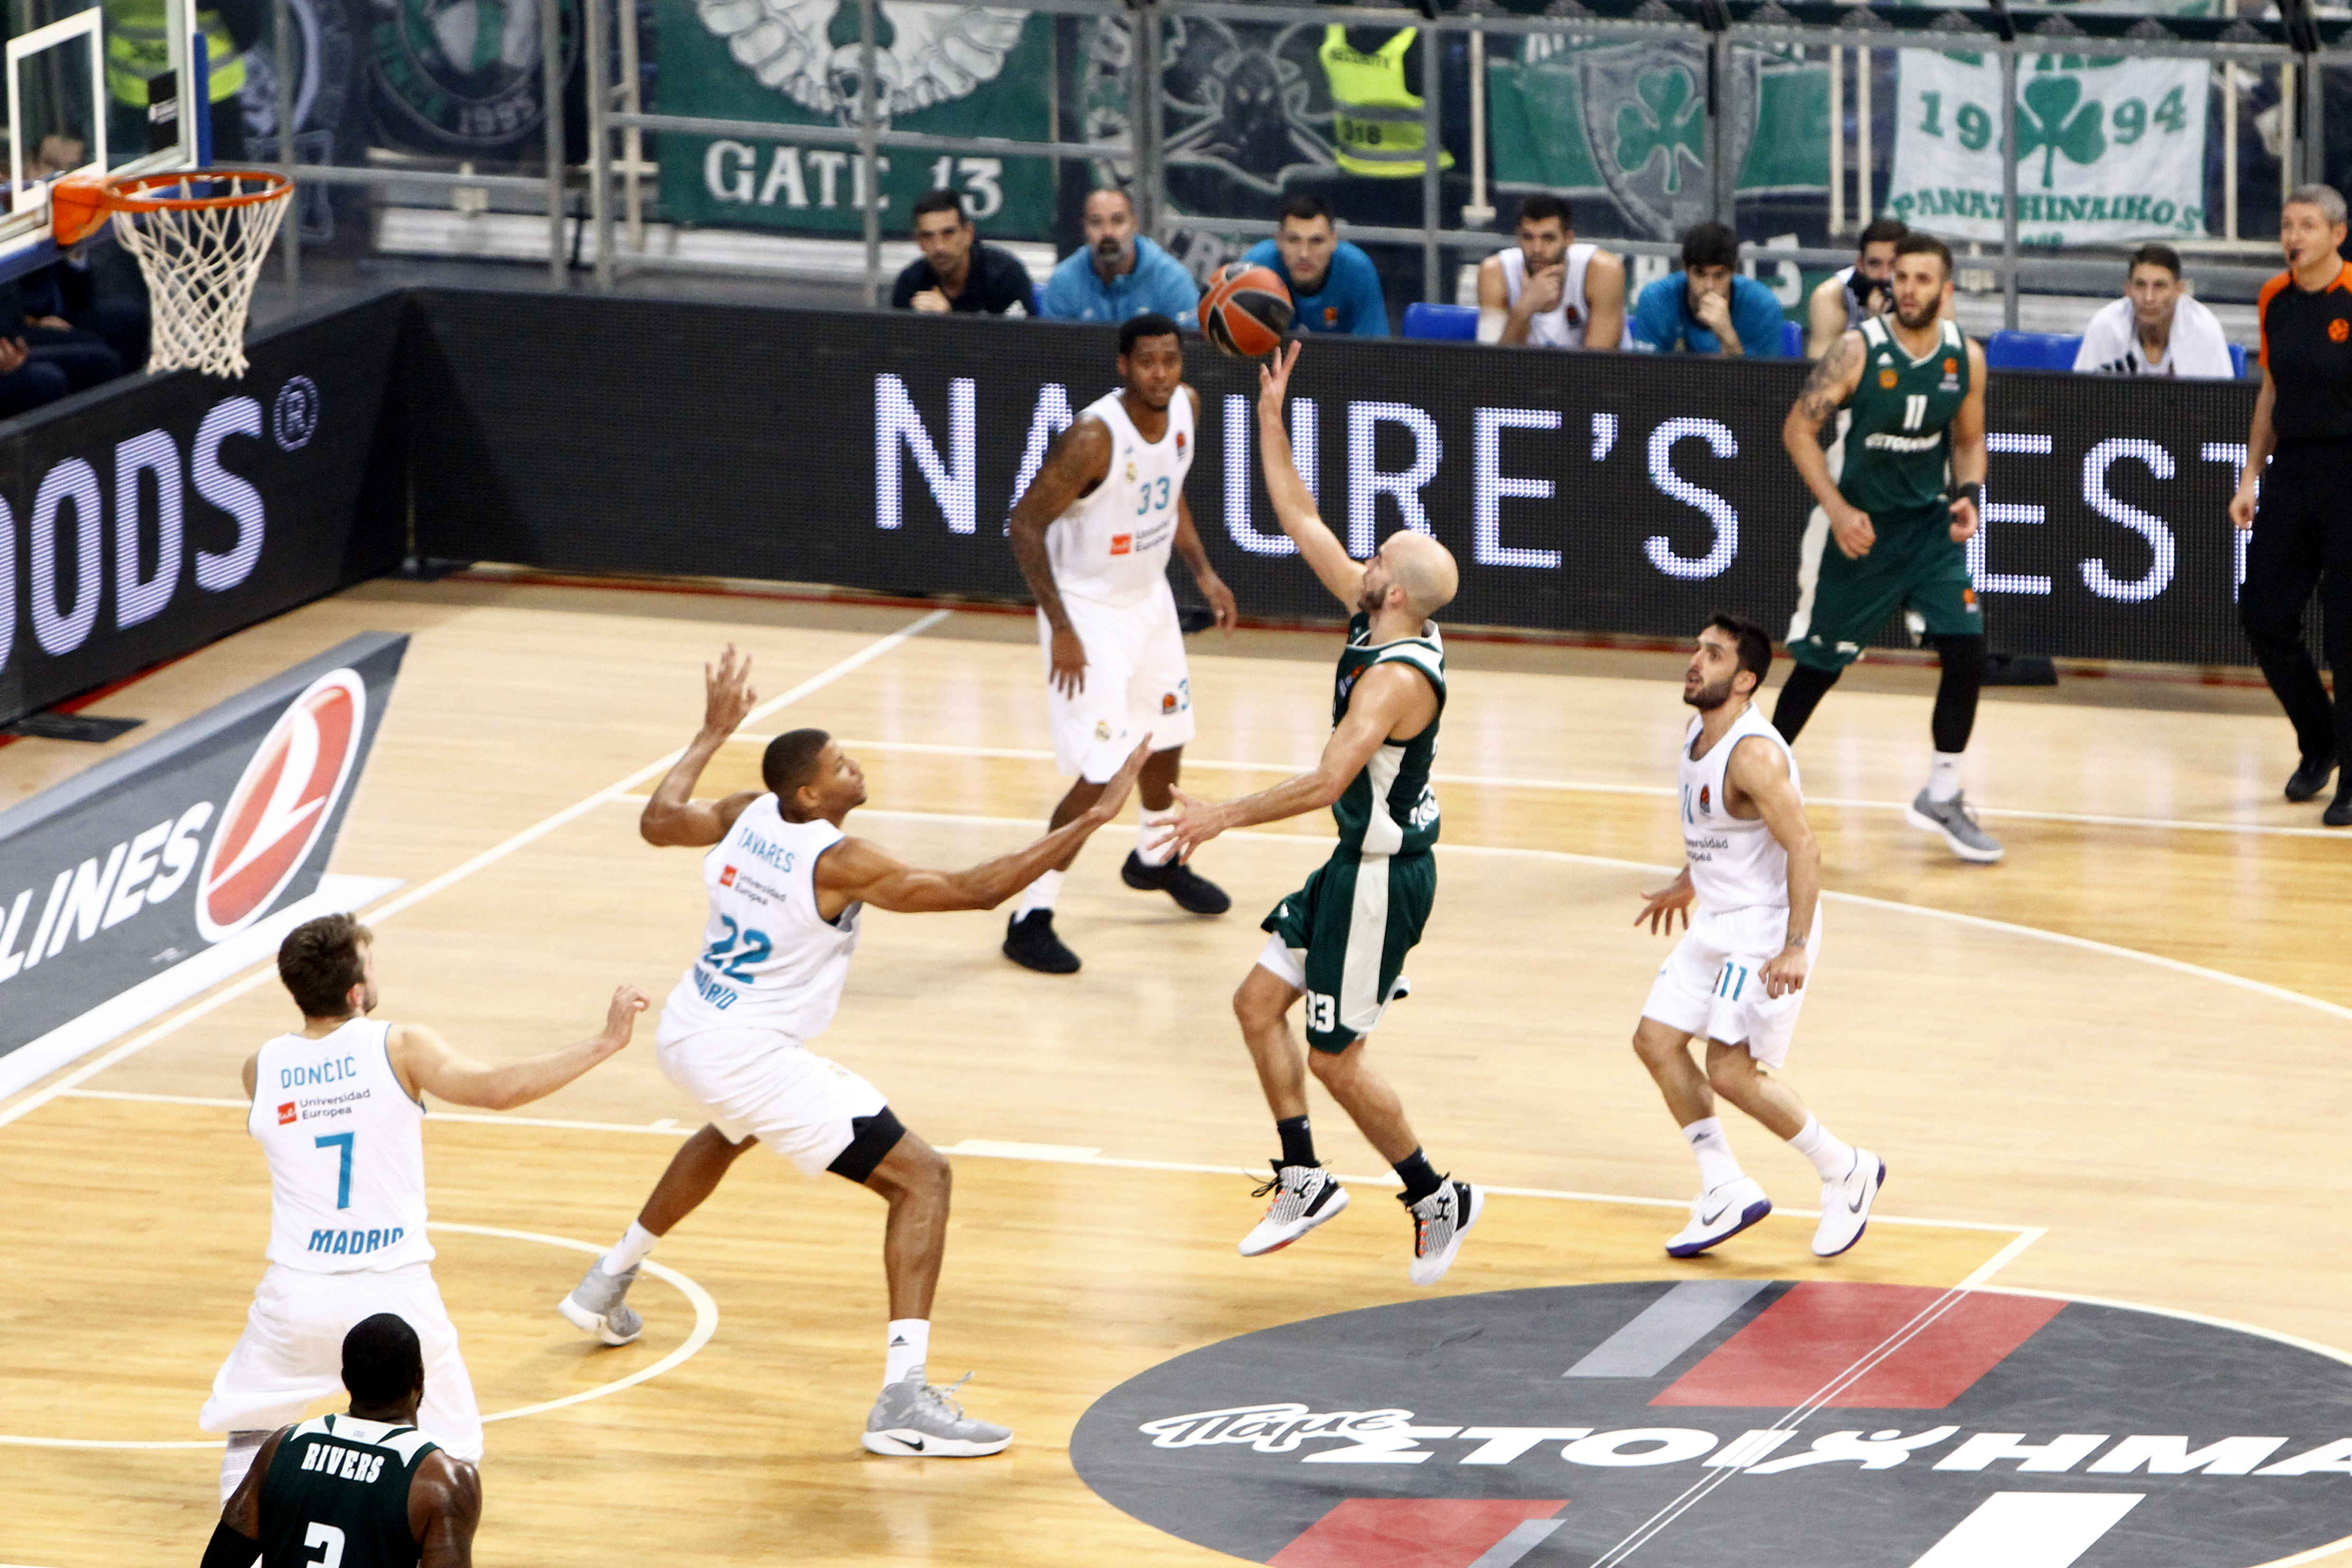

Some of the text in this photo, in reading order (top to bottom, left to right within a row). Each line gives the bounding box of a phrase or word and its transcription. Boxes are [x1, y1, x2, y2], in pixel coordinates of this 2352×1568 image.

[1919, 83, 2187, 151] 19 94
[704, 140, 1002, 220] GATE 13
[1892, 187, 2205, 232] PANATHINAIKOS
[1903, 394, 1928, 431] 11
[875, 373, 1739, 581] NAURE'S
[1137, 476, 1170, 515] 33
[738, 826, 796, 873] TAVARES
[0, 800, 214, 982] LINES
[704, 913, 773, 984] 22
[1720, 961, 1748, 1001] 11
[300, 1089, 370, 1108] Universidad
[302, 1106, 352, 1119] Europea
[314, 1131, 355, 1210] 7
[307, 1228, 404, 1255] MADRID
[301, 1442, 384, 1483] RIVERS
